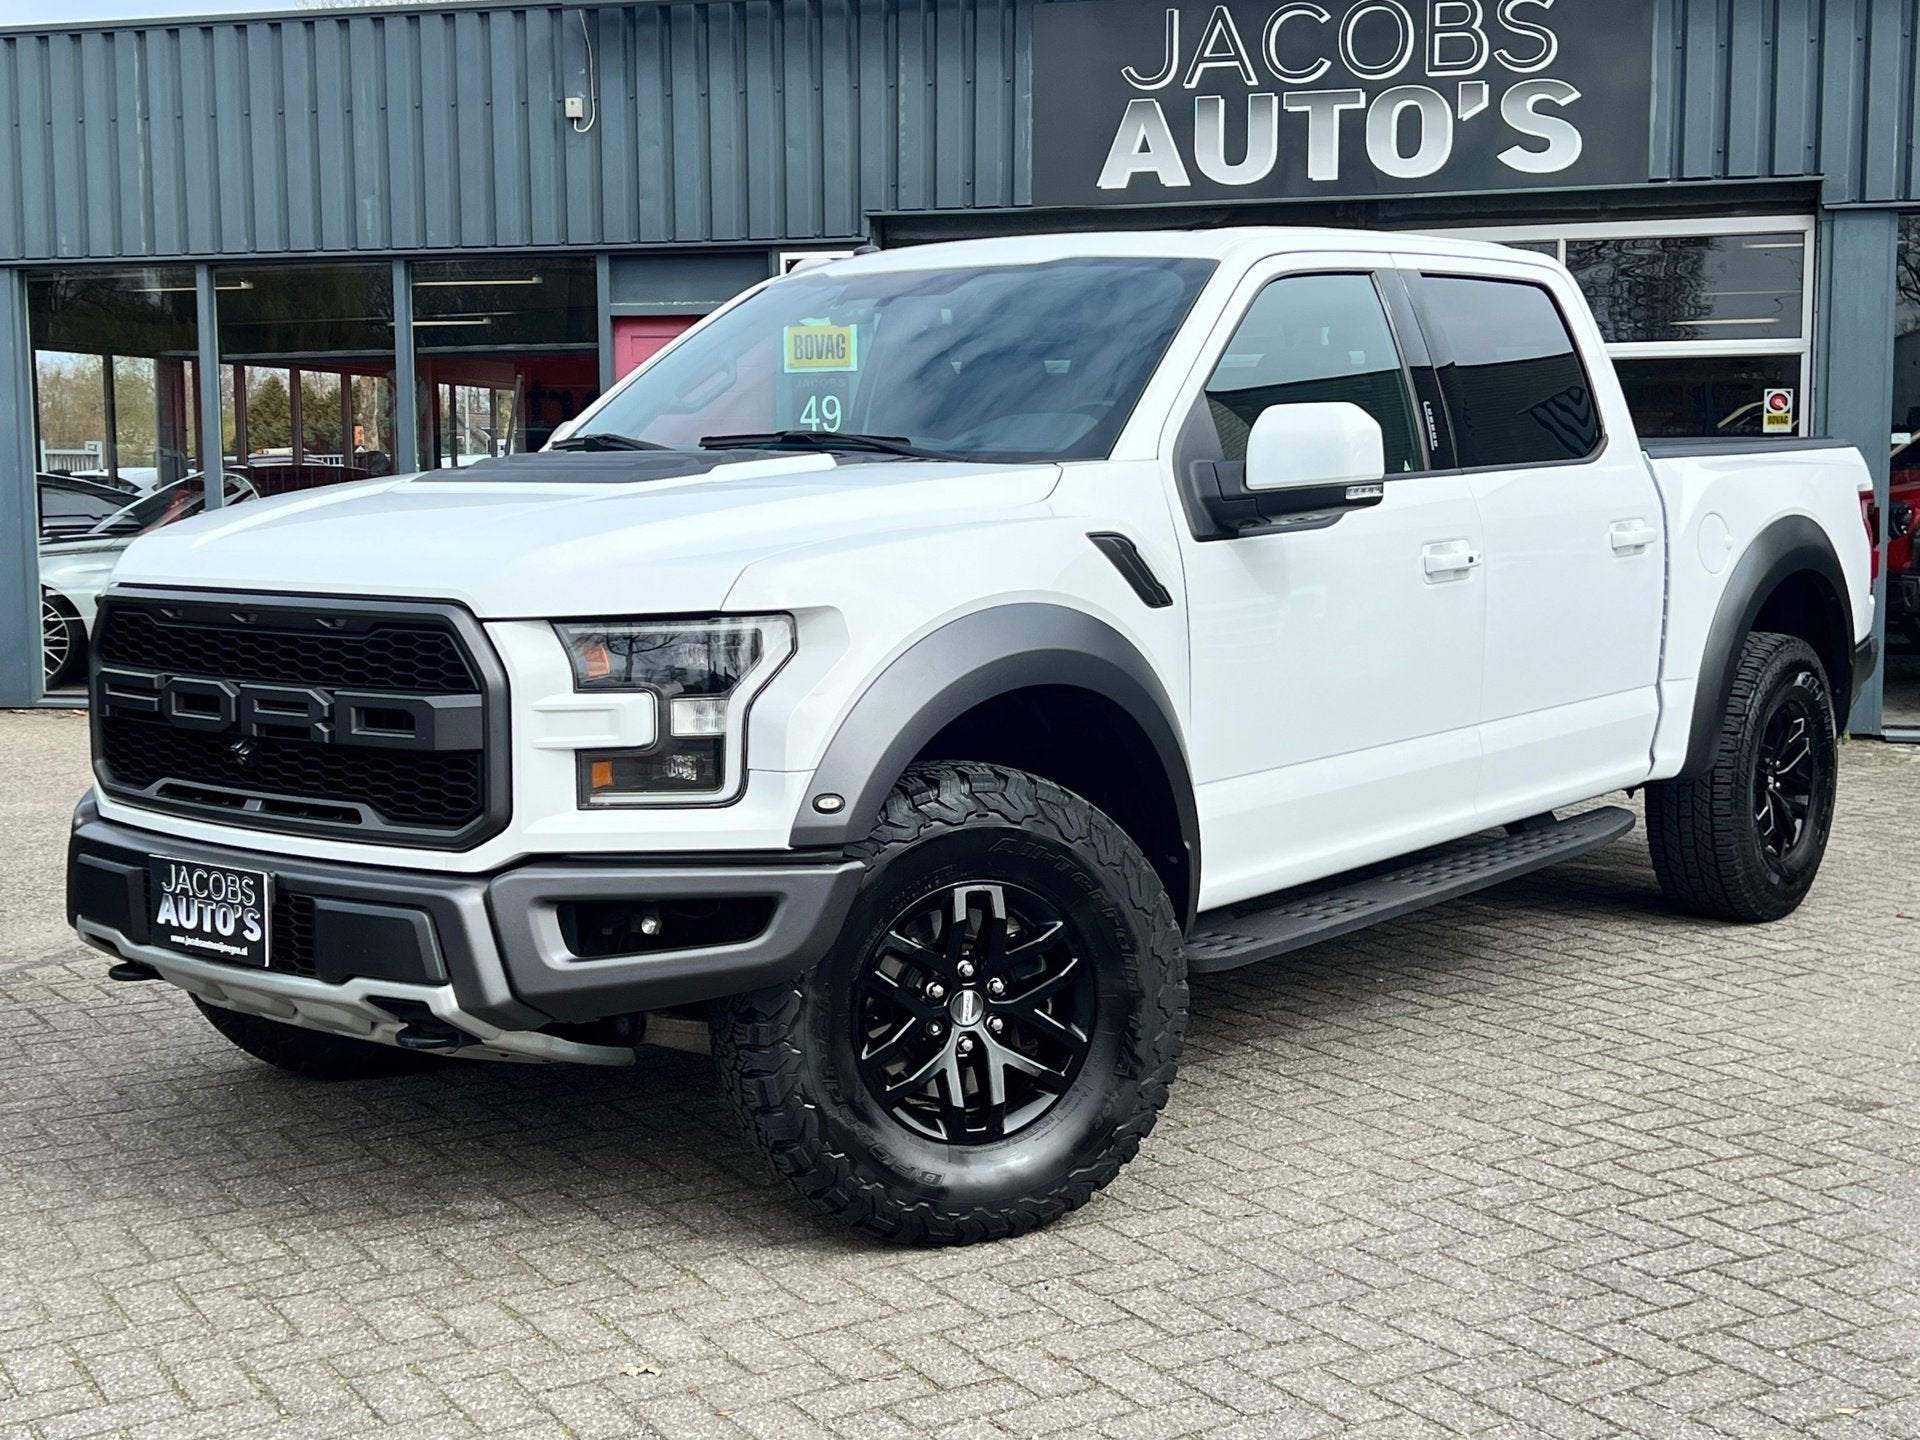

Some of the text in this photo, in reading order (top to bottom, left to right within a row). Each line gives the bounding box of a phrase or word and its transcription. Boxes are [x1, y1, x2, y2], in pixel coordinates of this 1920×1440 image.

[1122, 0, 1559, 90] JACOBS
[1096, 78, 1583, 189] AUTO'S
[793, 332, 846, 361] BOVAG
[799, 394, 842, 433] 49
[98, 666, 440, 751] FORD
[161, 863, 256, 906] JACOBS
[156, 892, 262, 942] AUTO'S
